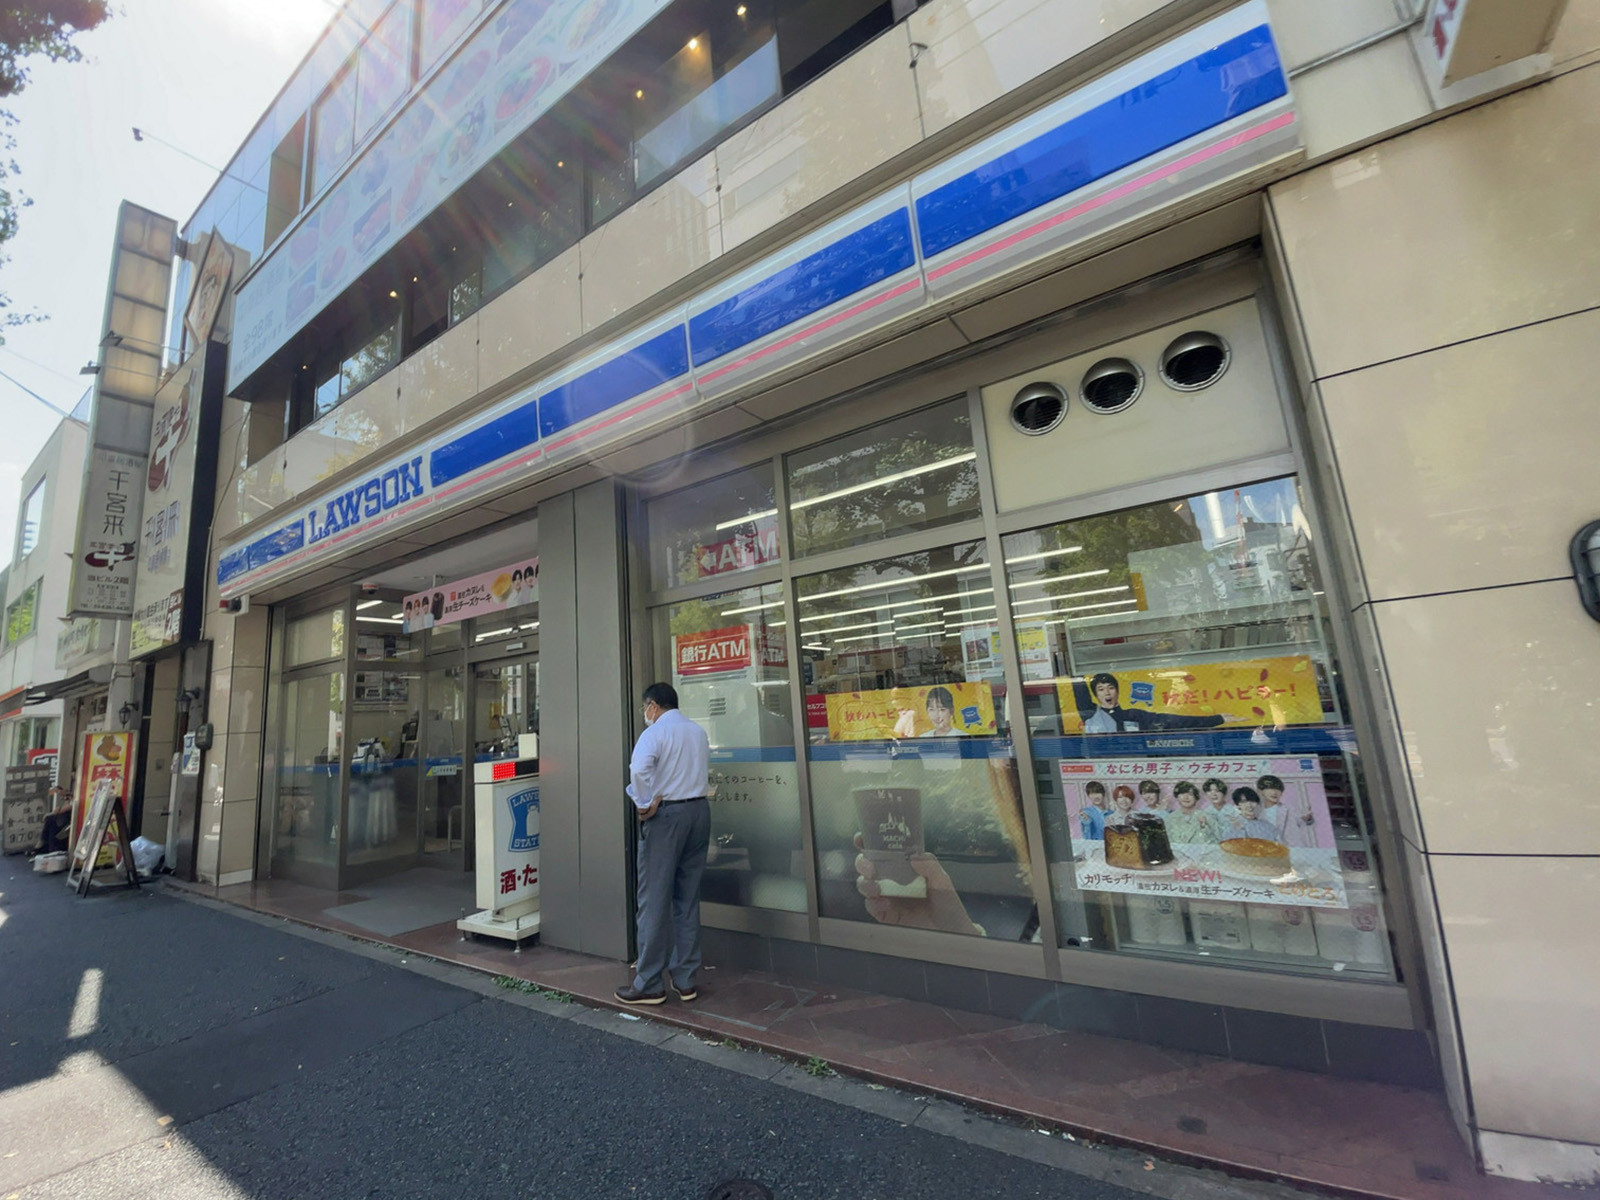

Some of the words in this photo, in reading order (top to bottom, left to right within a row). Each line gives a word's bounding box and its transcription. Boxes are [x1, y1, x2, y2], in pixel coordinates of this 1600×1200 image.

[308, 455, 424, 545] LAWSON
[719, 530, 778, 570] ATM
[681, 638, 746, 664] 銀行ATM
[1146, 739, 1195, 748] LAWSON
[1173, 867, 1223, 884] NEW!
